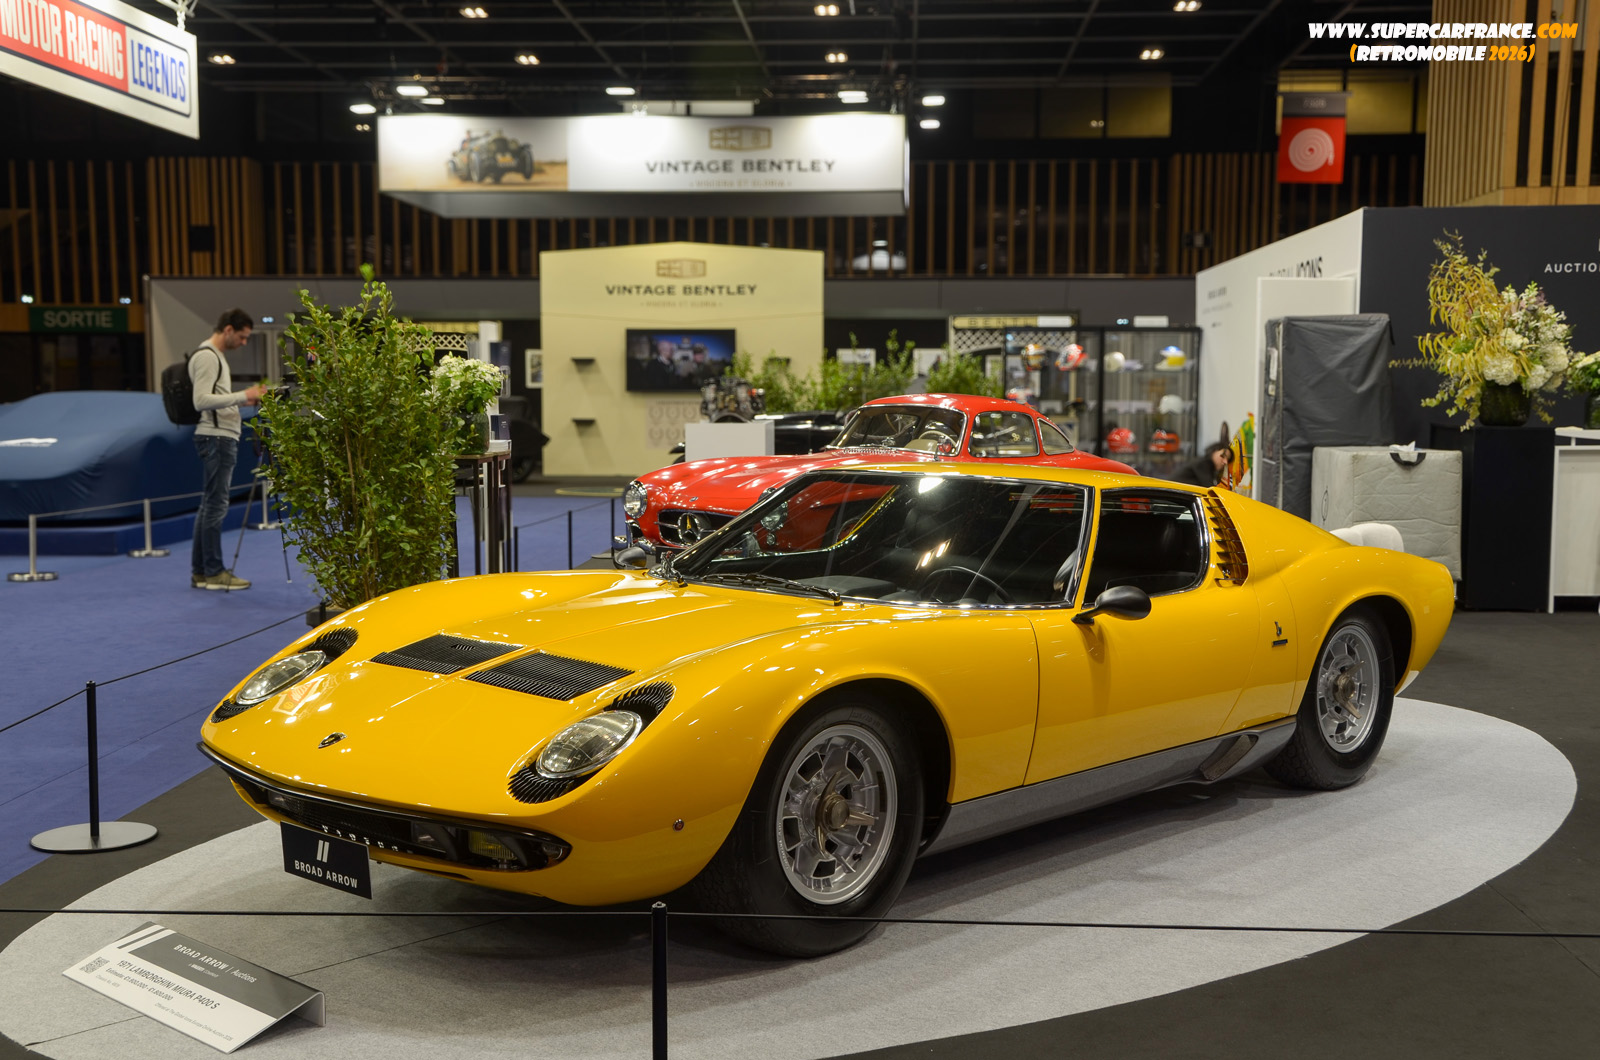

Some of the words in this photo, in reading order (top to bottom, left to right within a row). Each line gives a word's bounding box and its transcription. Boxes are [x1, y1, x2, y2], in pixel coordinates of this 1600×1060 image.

[0, 0, 64, 58] MOTOR
[65, 10, 125, 80] RACING
[130, 39, 186, 103] LEGENDS
[646, 159, 735, 173] VINTAGE
[742, 158, 836, 173] BENTLEY
[1544, 262, 1600, 273] AUCTIO
[605, 284, 677, 296] VINTAGE
[683, 284, 758, 296] BENTLEY
[43, 310, 114, 328] SORTIE
[294, 860, 323, 877] BROAD
[326, 870, 358, 889] ARROW
[173, 944, 201, 958] BROAD
[198, 955, 230, 970] ARROW
[230, 969, 257, 983] Auctions
[117, 960, 132, 969] 1971
[130, 965, 176, 989] LAMBORGHINI
[171, 985, 197, 999] MIURA
[192, 994, 213, 1007] P400
[210, 1002, 220, 1010] S
